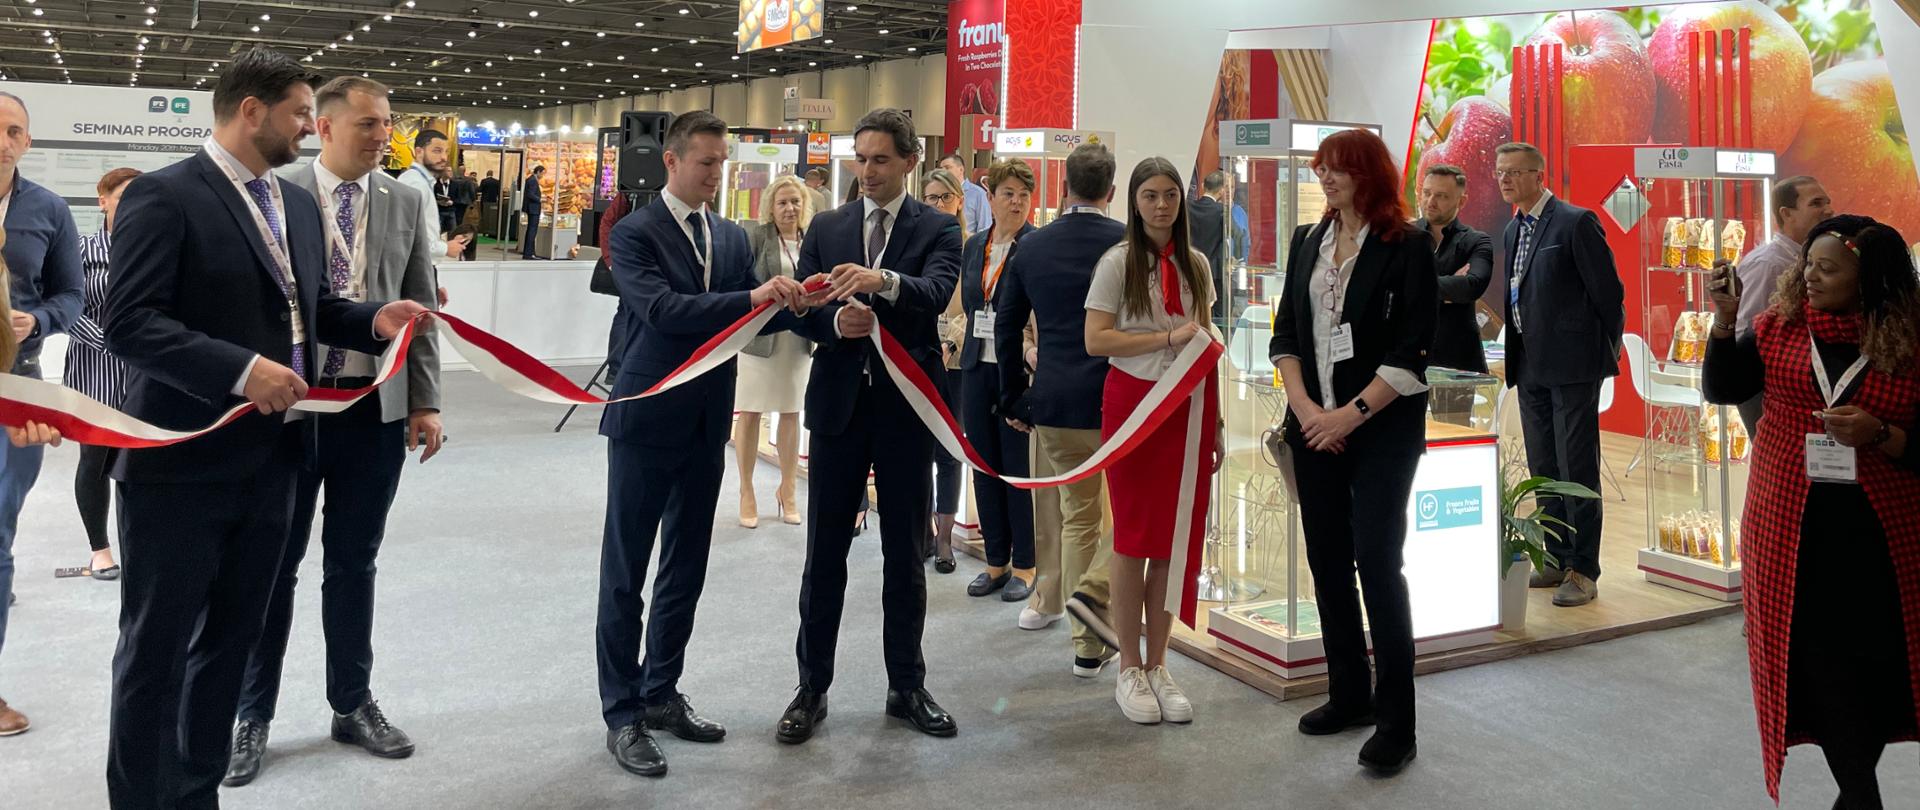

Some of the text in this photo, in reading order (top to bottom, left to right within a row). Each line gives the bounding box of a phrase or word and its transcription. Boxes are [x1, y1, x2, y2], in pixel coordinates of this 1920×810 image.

[957, 53, 970, 62] Fresh
[970, 50, 998, 61] Raspberries
[803, 104, 832, 113] ITALIA
[73, 122, 144, 136] SEMINAR
[127, 143, 159, 153] Monday
[1662, 149, 1676, 160] GI
[1658, 159, 1683, 168] Pasta
[1423, 501, 1434, 512] HF
